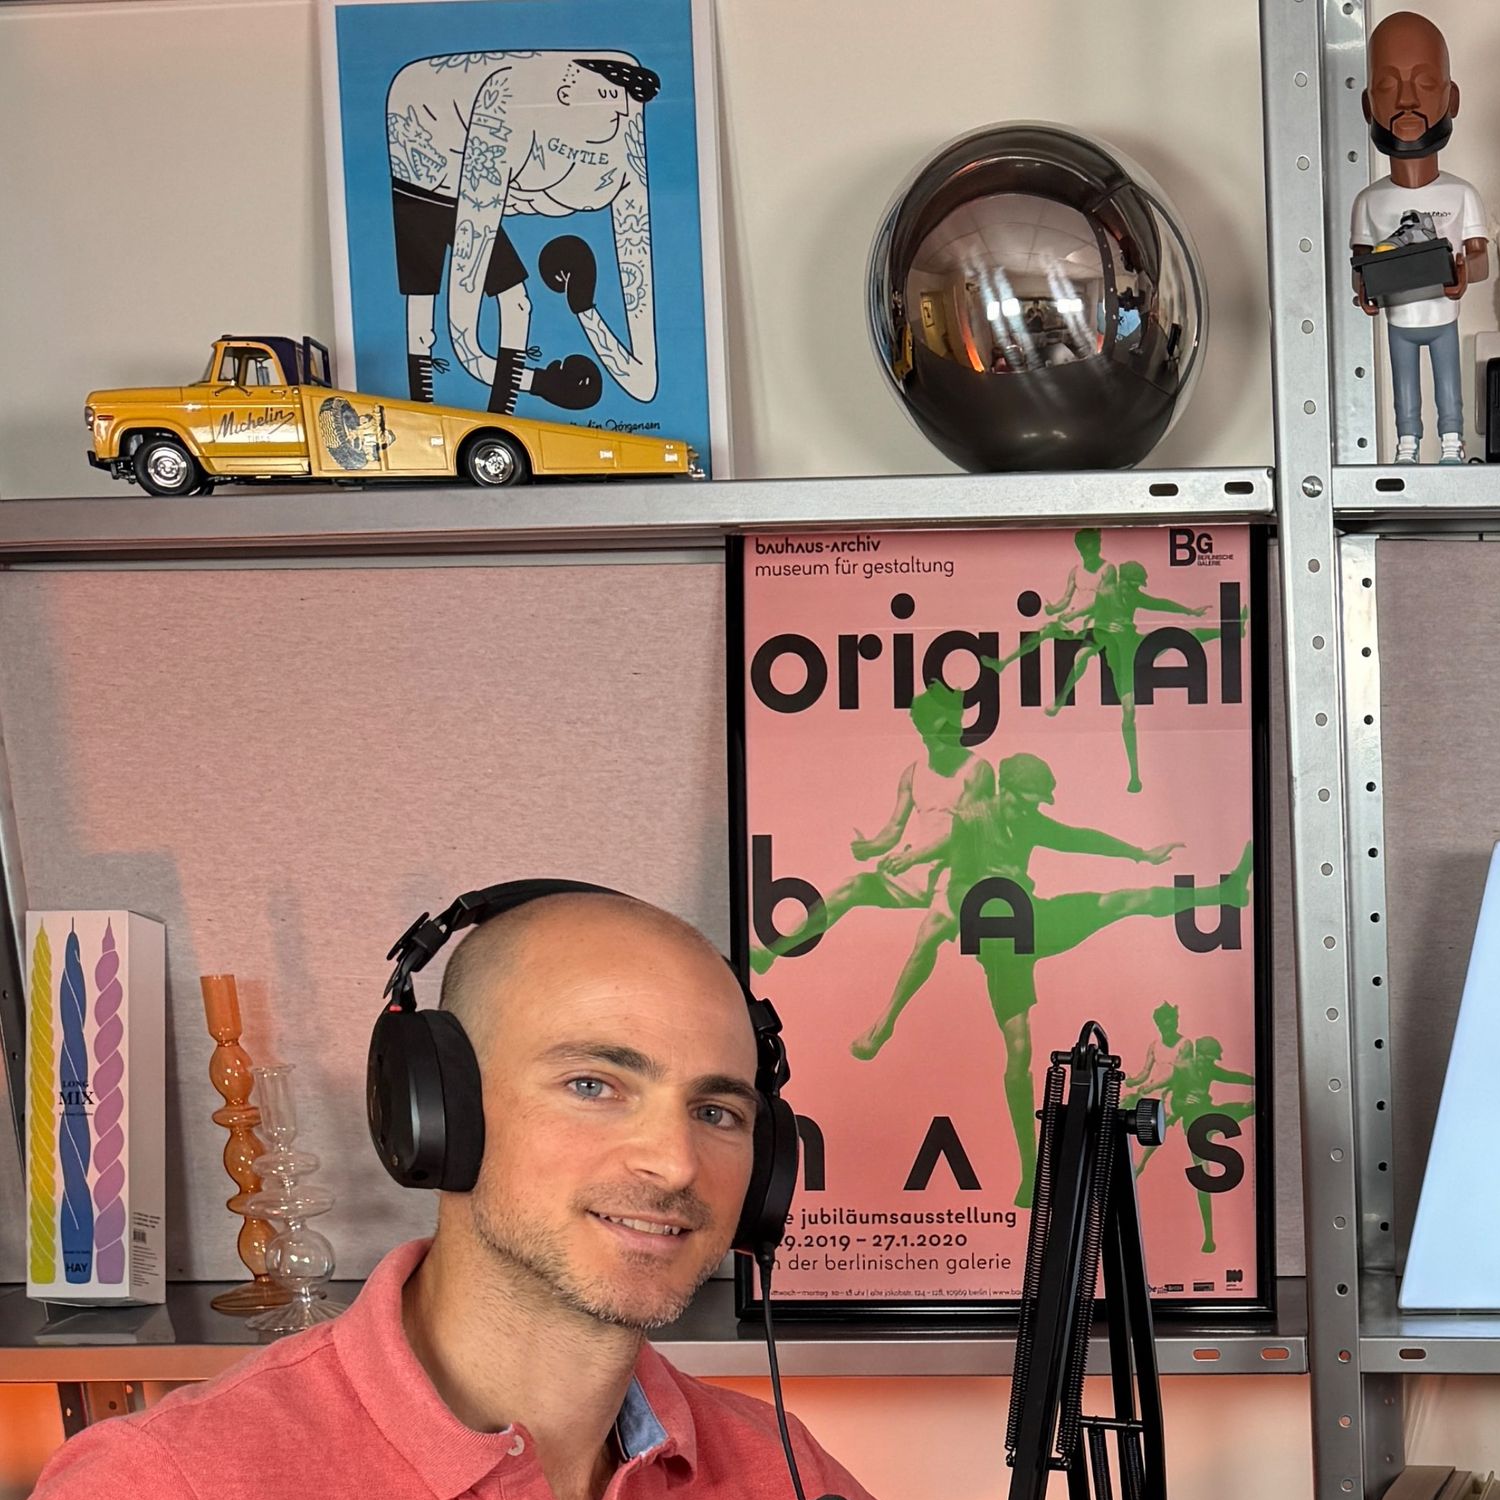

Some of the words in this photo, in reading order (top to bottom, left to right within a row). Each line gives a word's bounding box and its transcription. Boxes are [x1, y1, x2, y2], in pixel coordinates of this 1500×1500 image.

[547, 138, 609, 165] GENTLE
[216, 407, 295, 439] Michelin
[755, 560, 829, 578] museum
[834, 557, 860, 576] für
[862, 556, 954, 579] gestaltung
[750, 582, 1242, 747] original
[62, 1080, 90, 1088] LONG
[58, 1091, 94, 1105] MIX
[800, 1206, 1017, 1228] jubiläumsausstellung
[778, 1233, 851, 1251] .9.2019
[872, 1233, 968, 1251] 27.1.2020
[65, 1263, 88, 1273] HAY
[788, 1255, 818, 1271] der
[824, 1254, 939, 1271] berlinischen
[946, 1253, 1012, 1274] galerie
